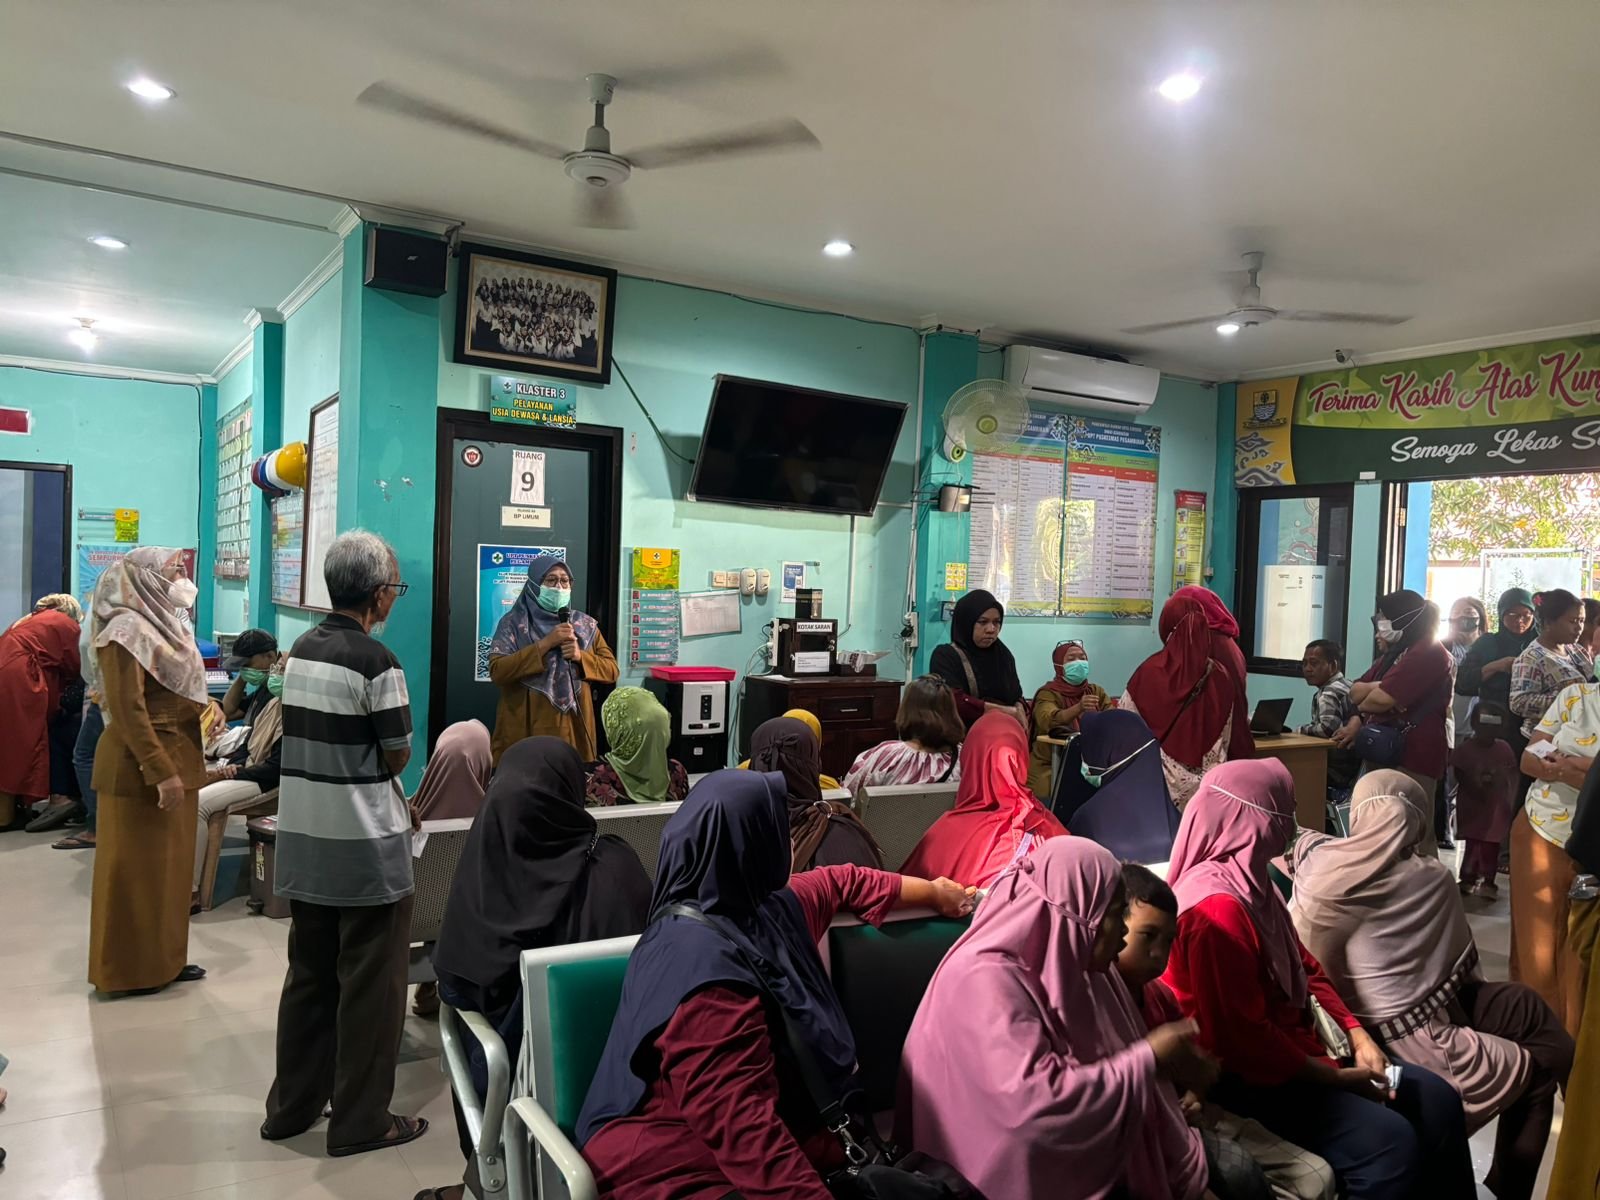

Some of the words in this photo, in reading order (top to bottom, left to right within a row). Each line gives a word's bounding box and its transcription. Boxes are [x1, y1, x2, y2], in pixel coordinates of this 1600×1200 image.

[516, 383, 557, 398] KLASTER
[559, 389, 566, 399] 3
[1309, 383, 1381, 413] Terima
[1382, 372, 1455, 420] Kasih
[1457, 362, 1539, 416] Atas
[1541, 352, 1600, 406] Kun
[513, 399, 553, 411] PELAYANAN
[492, 407, 509, 417] USIA
[510, 409, 540, 420] DEWASA
[541, 412, 548, 421] &
[549, 414, 573, 424] LANSIA
[1391, 436, 1478, 464] Semoga
[1486, 428, 1561, 464] Lekas
[1571, 421, 1600, 450] S
[515, 451, 543, 460] RUANG
[521, 471, 535, 492] 9
